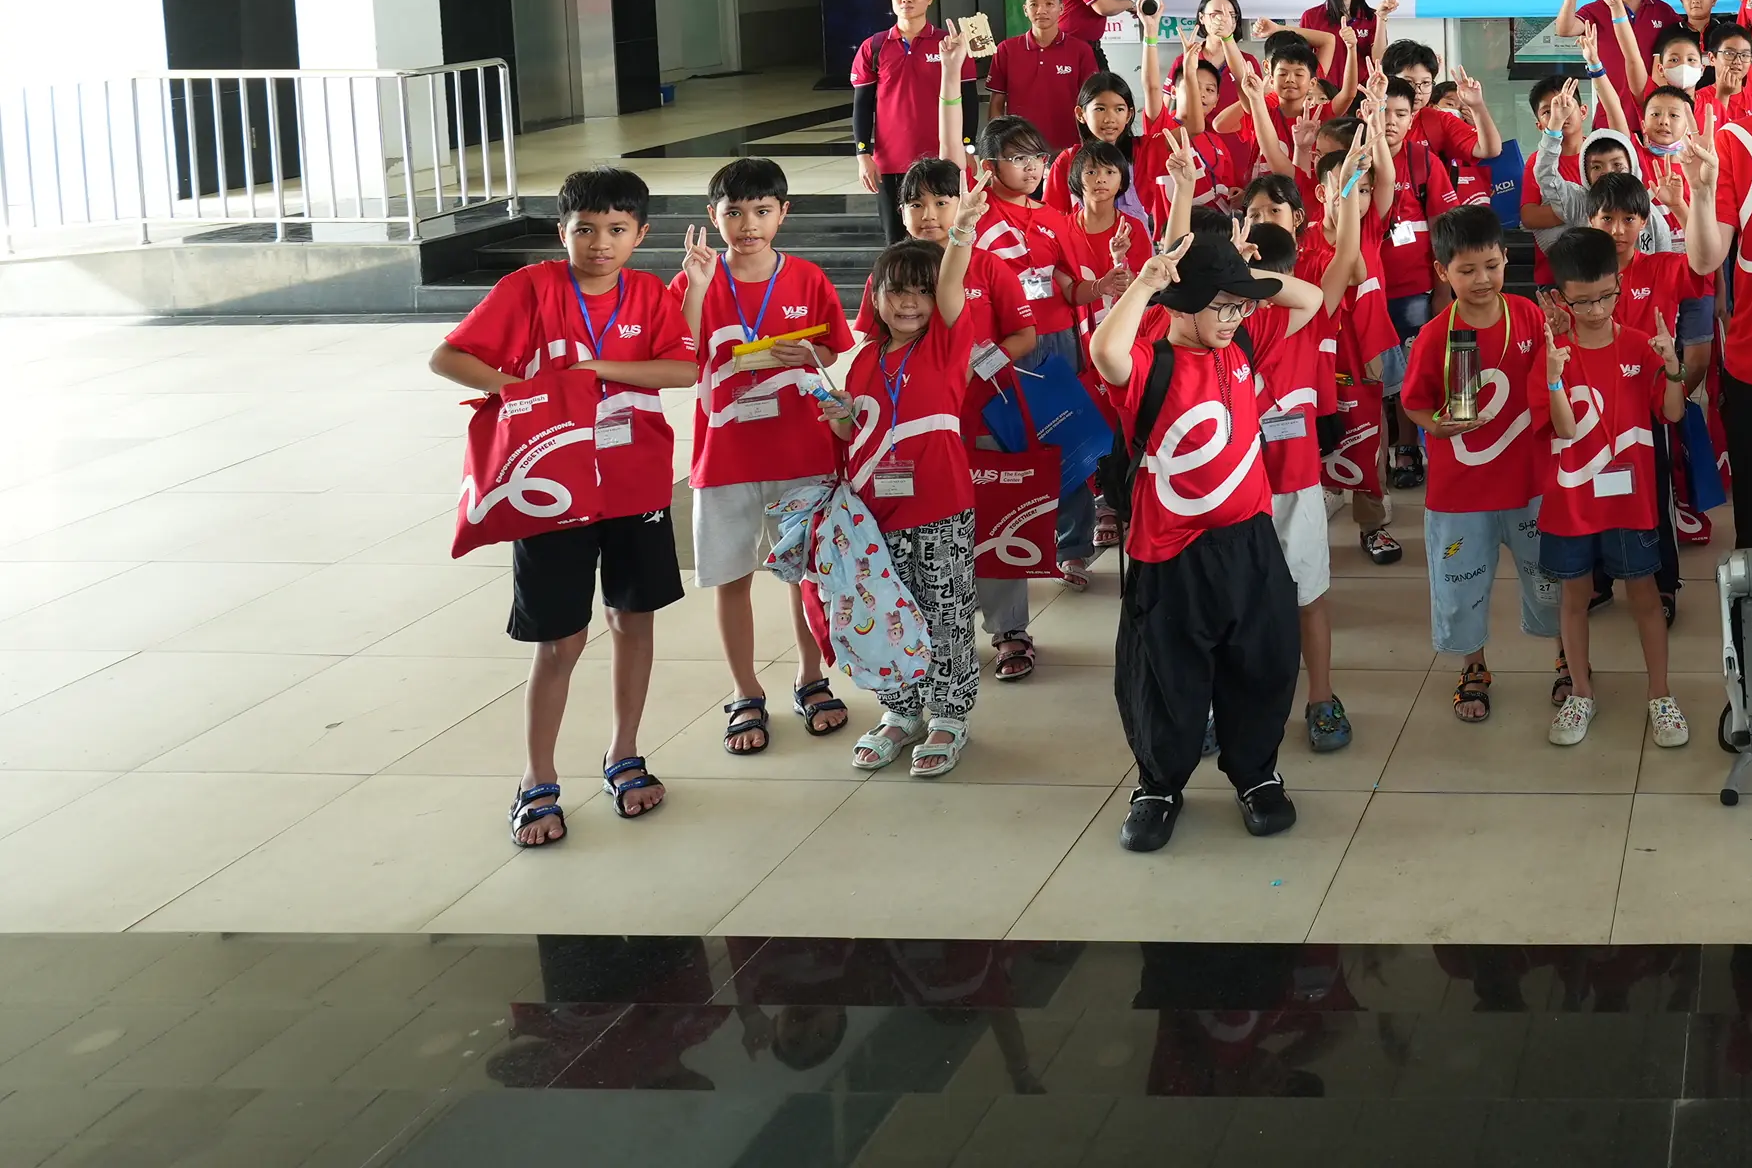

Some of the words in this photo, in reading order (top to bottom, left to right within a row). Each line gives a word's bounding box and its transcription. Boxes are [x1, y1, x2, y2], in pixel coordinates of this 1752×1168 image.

[1056, 64, 1072, 74] VUS
[1495, 180, 1515, 192] KDI
[1640, 232, 1653, 251] NY
[1631, 287, 1651, 298] VUS
[781, 305, 808, 318] VUS
[617, 324, 642, 336] VUS
[1516, 339, 1533, 352] VUS
[1620, 363, 1641, 375] VUS
[519, 395, 545, 407] English
[495, 443, 528, 483] EMPOWERING
[528, 420, 575, 445] ASPIRATIONS,
[520, 439, 557, 470] TOGETHER!
[969, 469, 999, 482] VUS
[1009, 508, 1038, 530] TOGETHER!
[1518, 517, 1539, 531] SHR
[1539, 583, 1551, 592] 27
